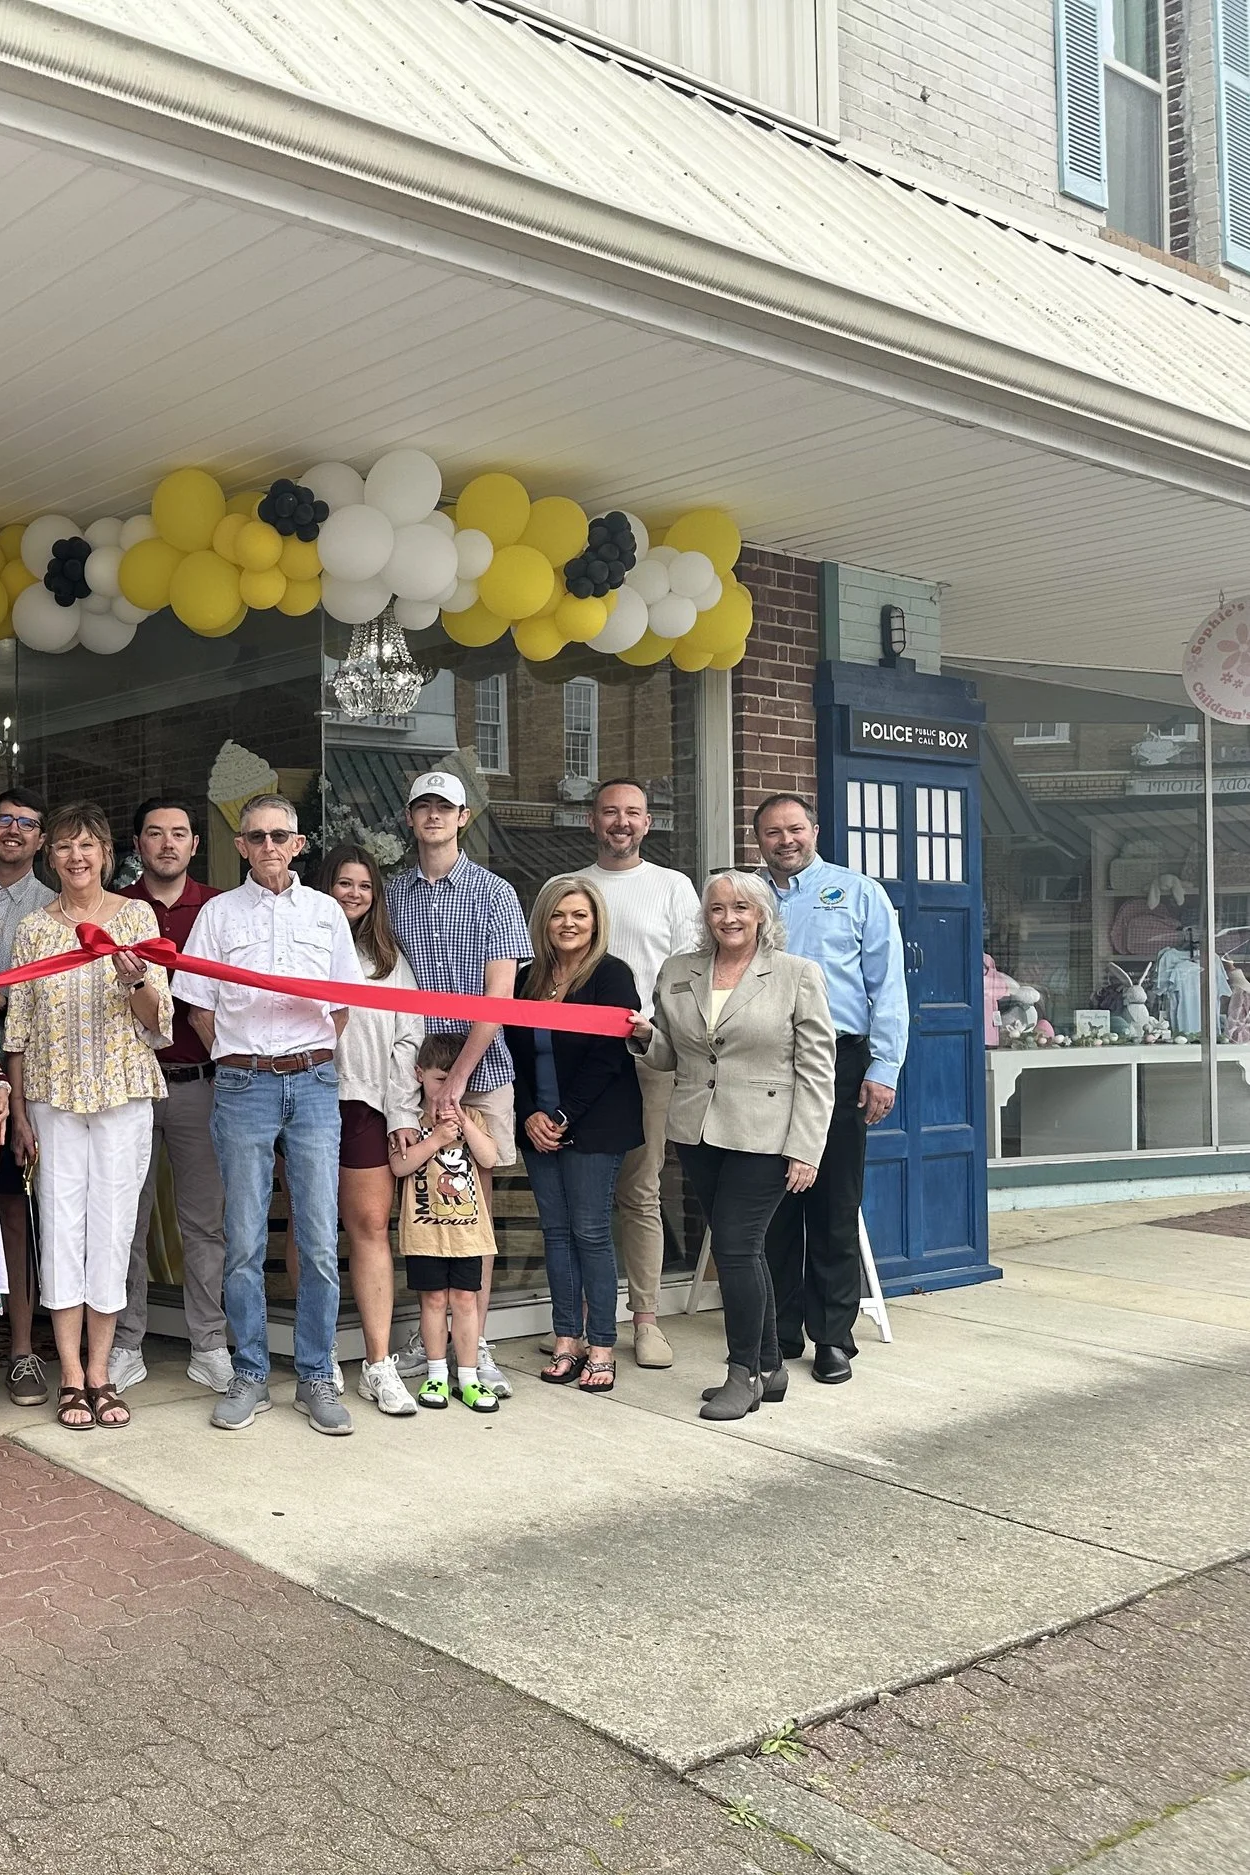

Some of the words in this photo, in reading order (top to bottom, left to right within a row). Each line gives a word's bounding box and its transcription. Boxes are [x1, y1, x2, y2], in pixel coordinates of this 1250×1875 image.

[1191, 603, 1246, 655] Sophie's
[862, 721, 913, 743] POLICE
[915, 727, 937, 737] PUBLIC
[918, 737, 935, 746] CALL
[938, 730, 968, 749] BOX
